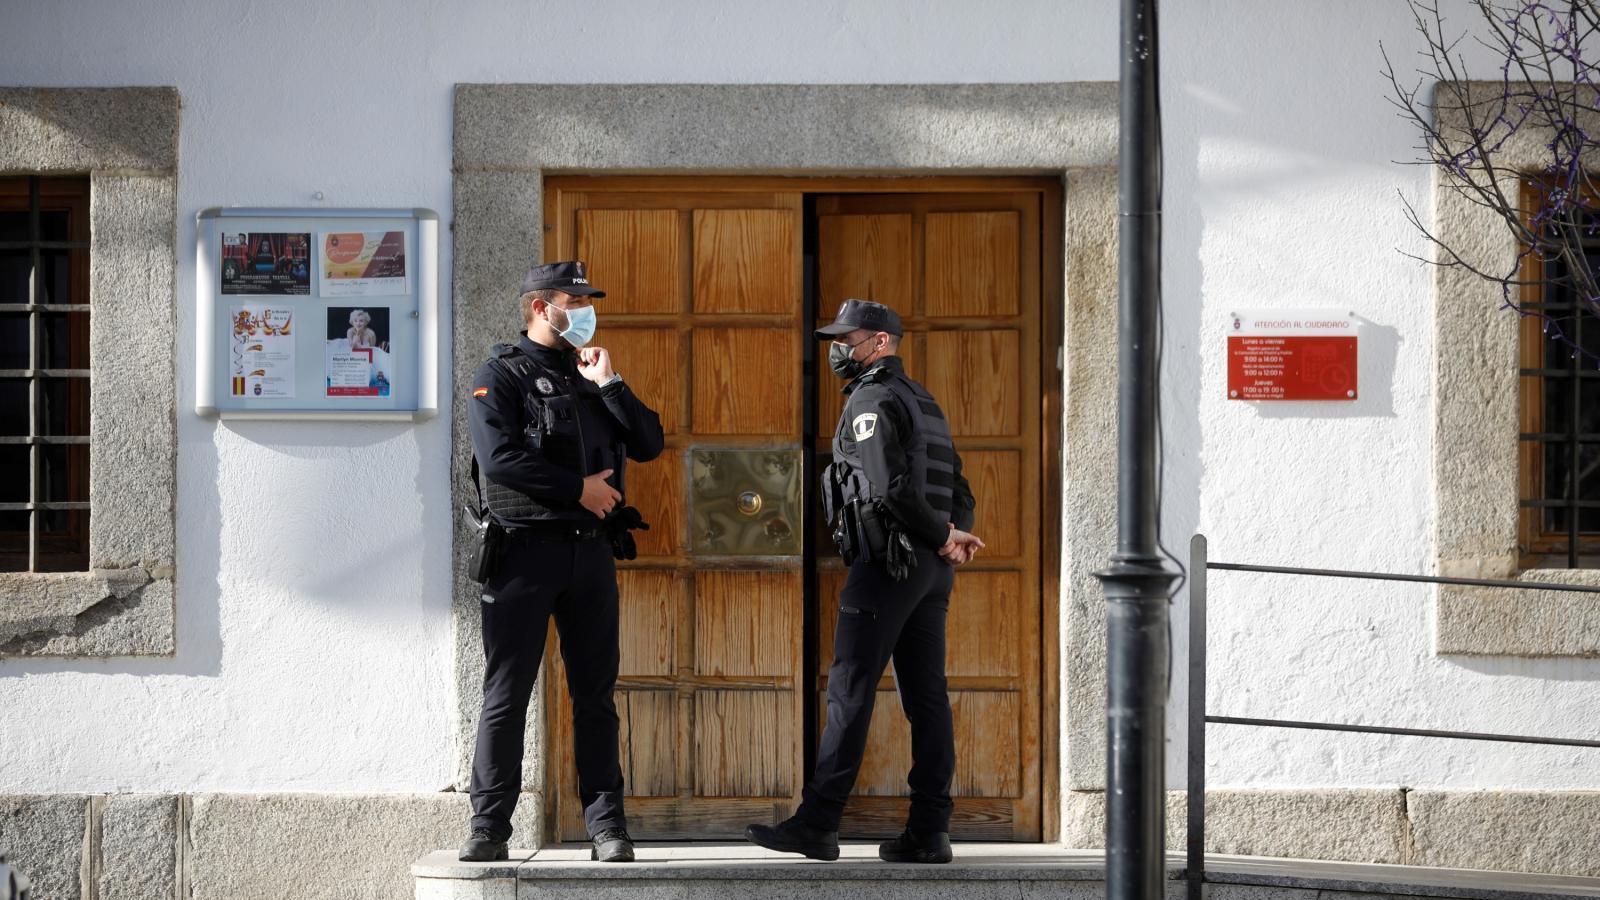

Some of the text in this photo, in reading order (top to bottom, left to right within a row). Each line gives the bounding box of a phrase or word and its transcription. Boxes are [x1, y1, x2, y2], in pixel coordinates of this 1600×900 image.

[1254, 320, 1350, 329] ATENCIÓN AL CIUDADANO
